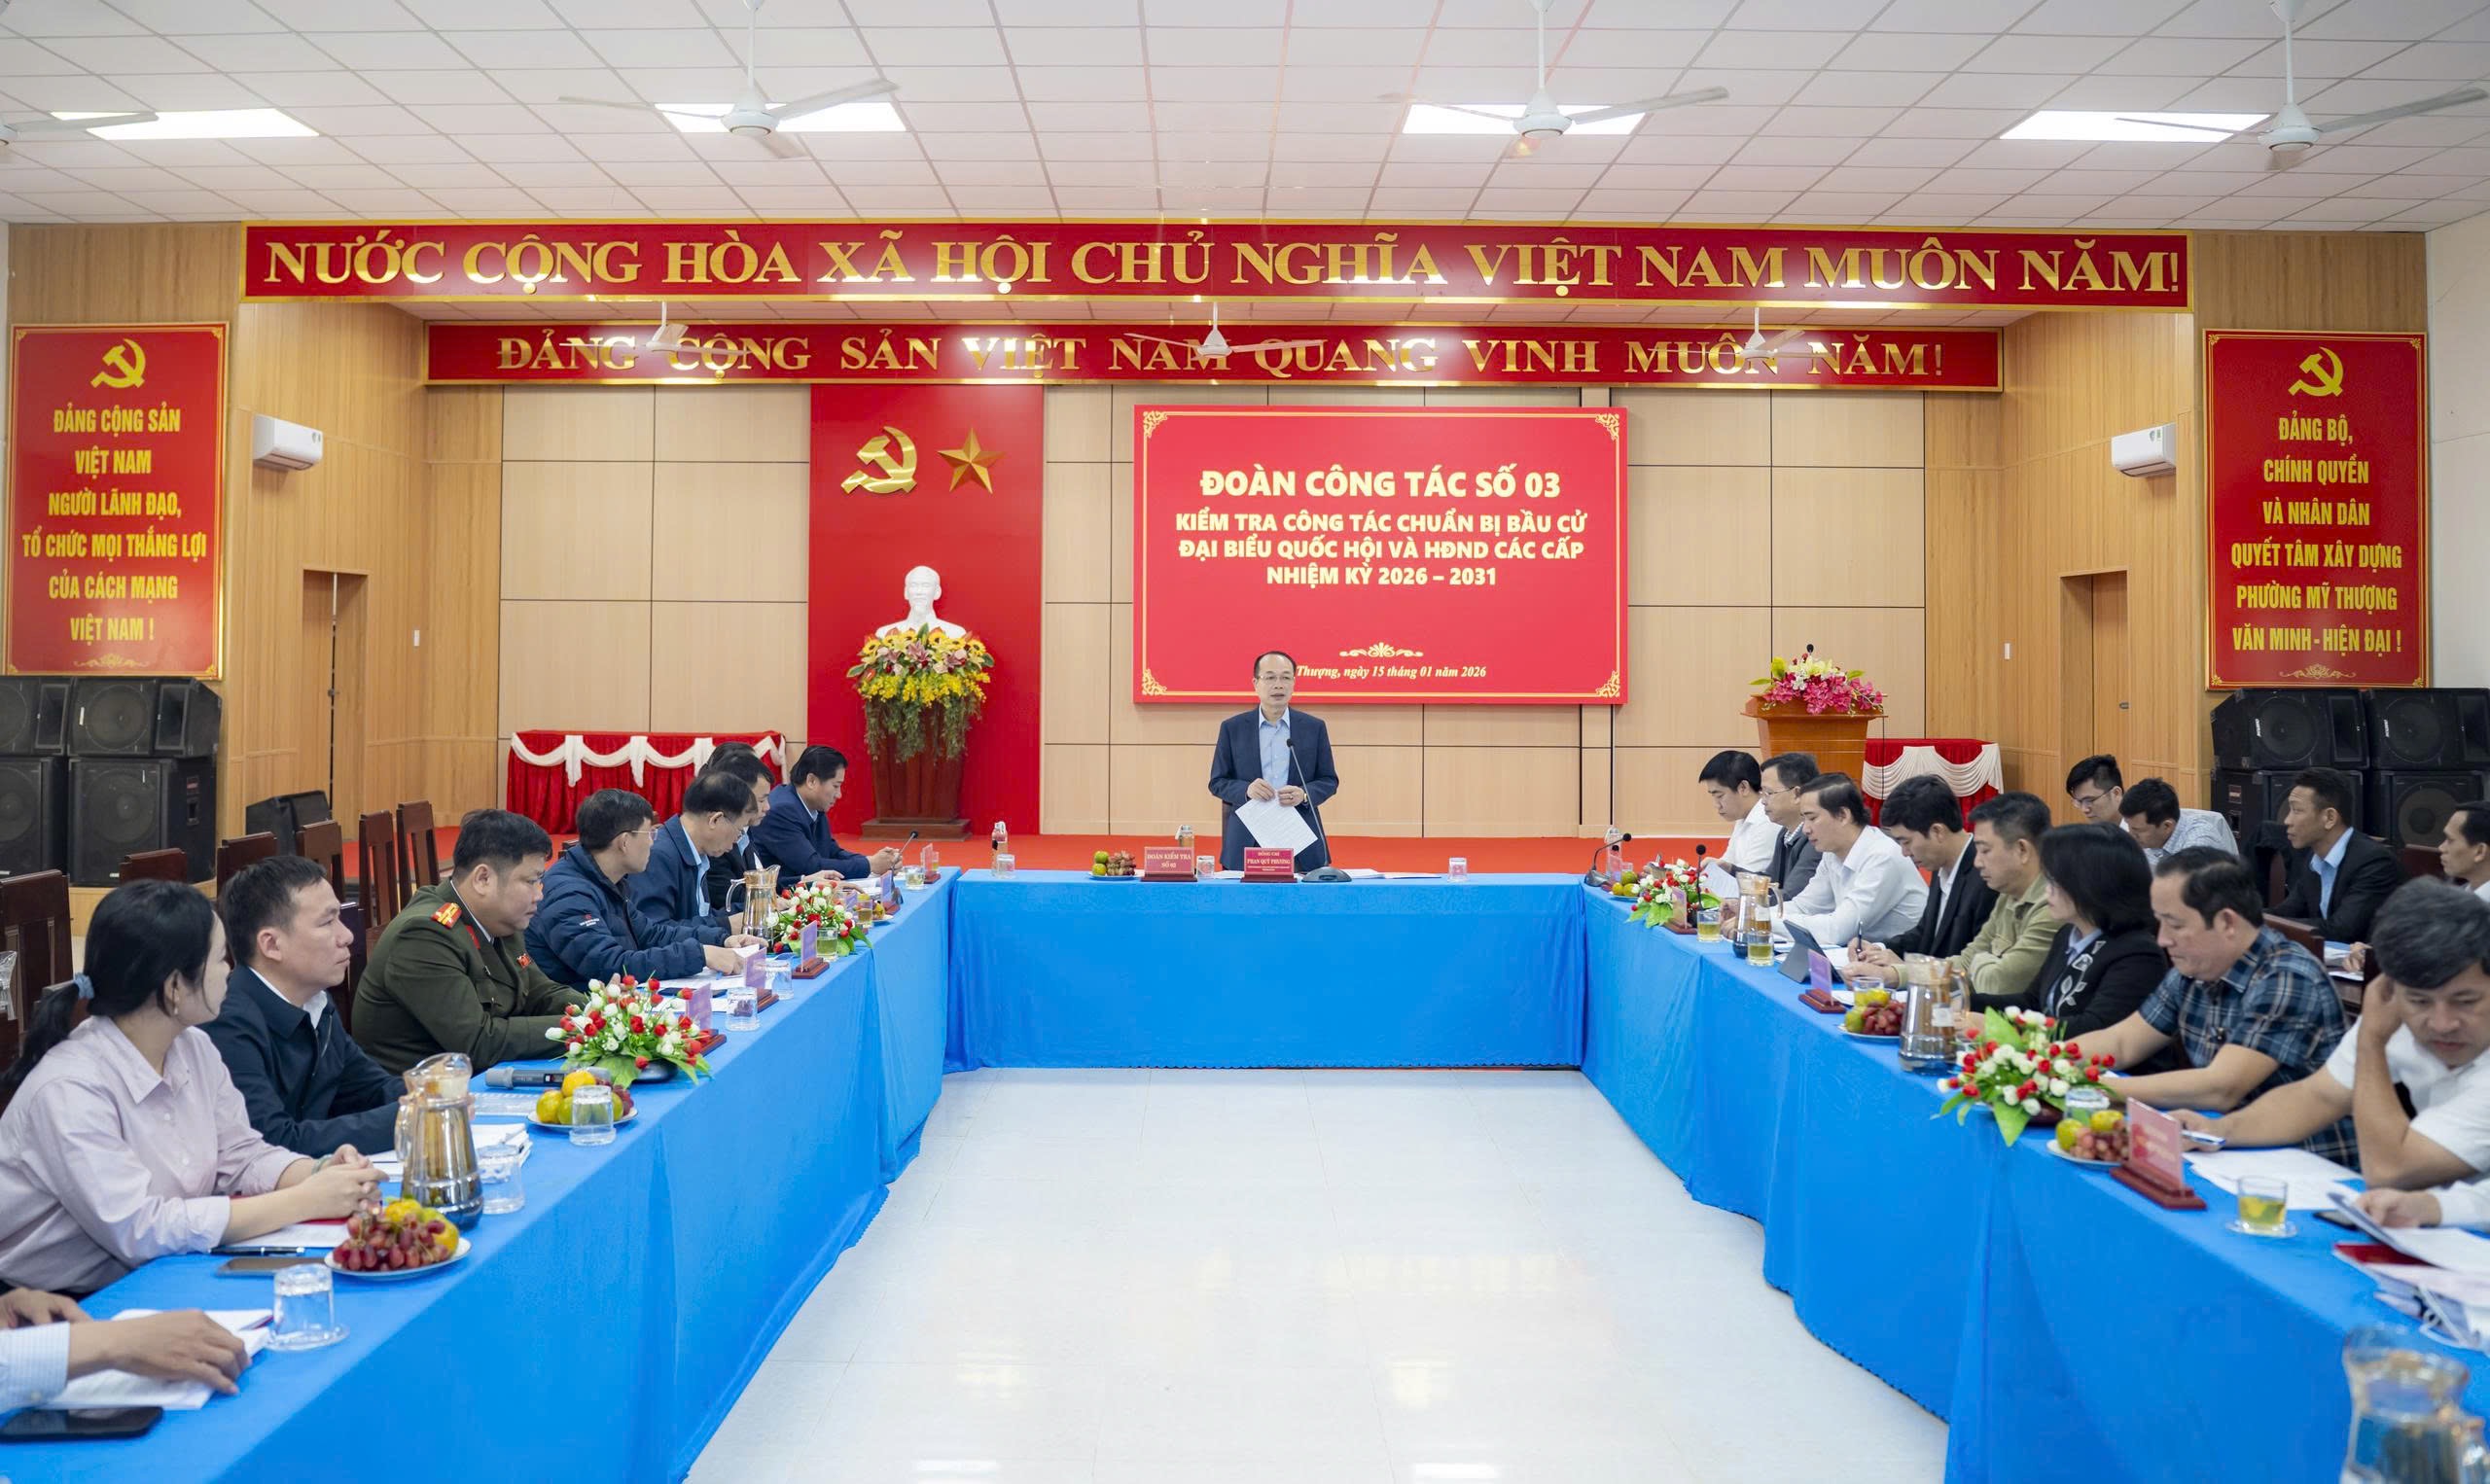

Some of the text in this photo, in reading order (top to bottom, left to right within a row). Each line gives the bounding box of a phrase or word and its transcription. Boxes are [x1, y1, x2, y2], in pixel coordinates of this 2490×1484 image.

[265, 230, 2180, 297] NƯỚC CỘNG HÒA XÃ HỘI CHỦ NGHĨA VIỆT NAM MUÔN NĂM!
[496, 329, 637, 371] ĐẢNG
[667, 333, 812, 378] CỘNG
[840, 328, 942, 370] SẢN
[961, 334, 1086, 378] VIỆT
[1109, 337, 1231, 373] NAM
[1254, 337, 1437, 378] QUANG
[1462, 339, 1600, 373] VINH
[1807, 334, 1943, 376] NĂM!
[53, 402, 181, 437] ĐẢNG CỘNG SẢN
[2279, 409, 2353, 446] ĐẢNG BỘ,
[75, 445, 152, 478] VIỆT NAM
[2263, 453, 2369, 486] CHÍNH QUYỀN
[1200, 463, 1561, 498] ĐOÀN CÔNG TÁC SỐ 03
[49, 487, 182, 520] NGƯỜI LÃNH ĐẠO,
[2262, 497, 2370, 526] VÀ NHÂN DÂN
[1176, 506, 1588, 537] KIỂM TRA CÔNG TÁC CHUẨN BỊ BẦU CỬ
[22, 525, 206, 562] TỔ CHỨC MỌI THẮNG LỢI
[1178, 533, 1584, 562] ĐẠI BIỂU QUỐC HỘI VÀ HĐND CÁC CẤP
[2231, 537, 2401, 573] QUYẾT TÂM XÂY DỰNG
[49, 569, 177, 604] CỦA CÁCH MẠNG
[1266, 562, 1338, 588] NHIỆM
[1345, 561, 1372, 584] KỲ
[1378, 567, 1428, 585] 2026
[1449, 567, 1496, 585] 2031
[2237, 580, 2398, 615] PHƯỜNG MỸ THƯỢNG
[70, 614, 103, 646] VIỆT
[108, 618, 143, 641] NAM
[2232, 622, 2264, 651] VĂN
[2365, 629, 2391, 656] ĐẠI
[1297, 665, 1487, 680] Thượng, ngày 15 tháng 01 năm 2026
